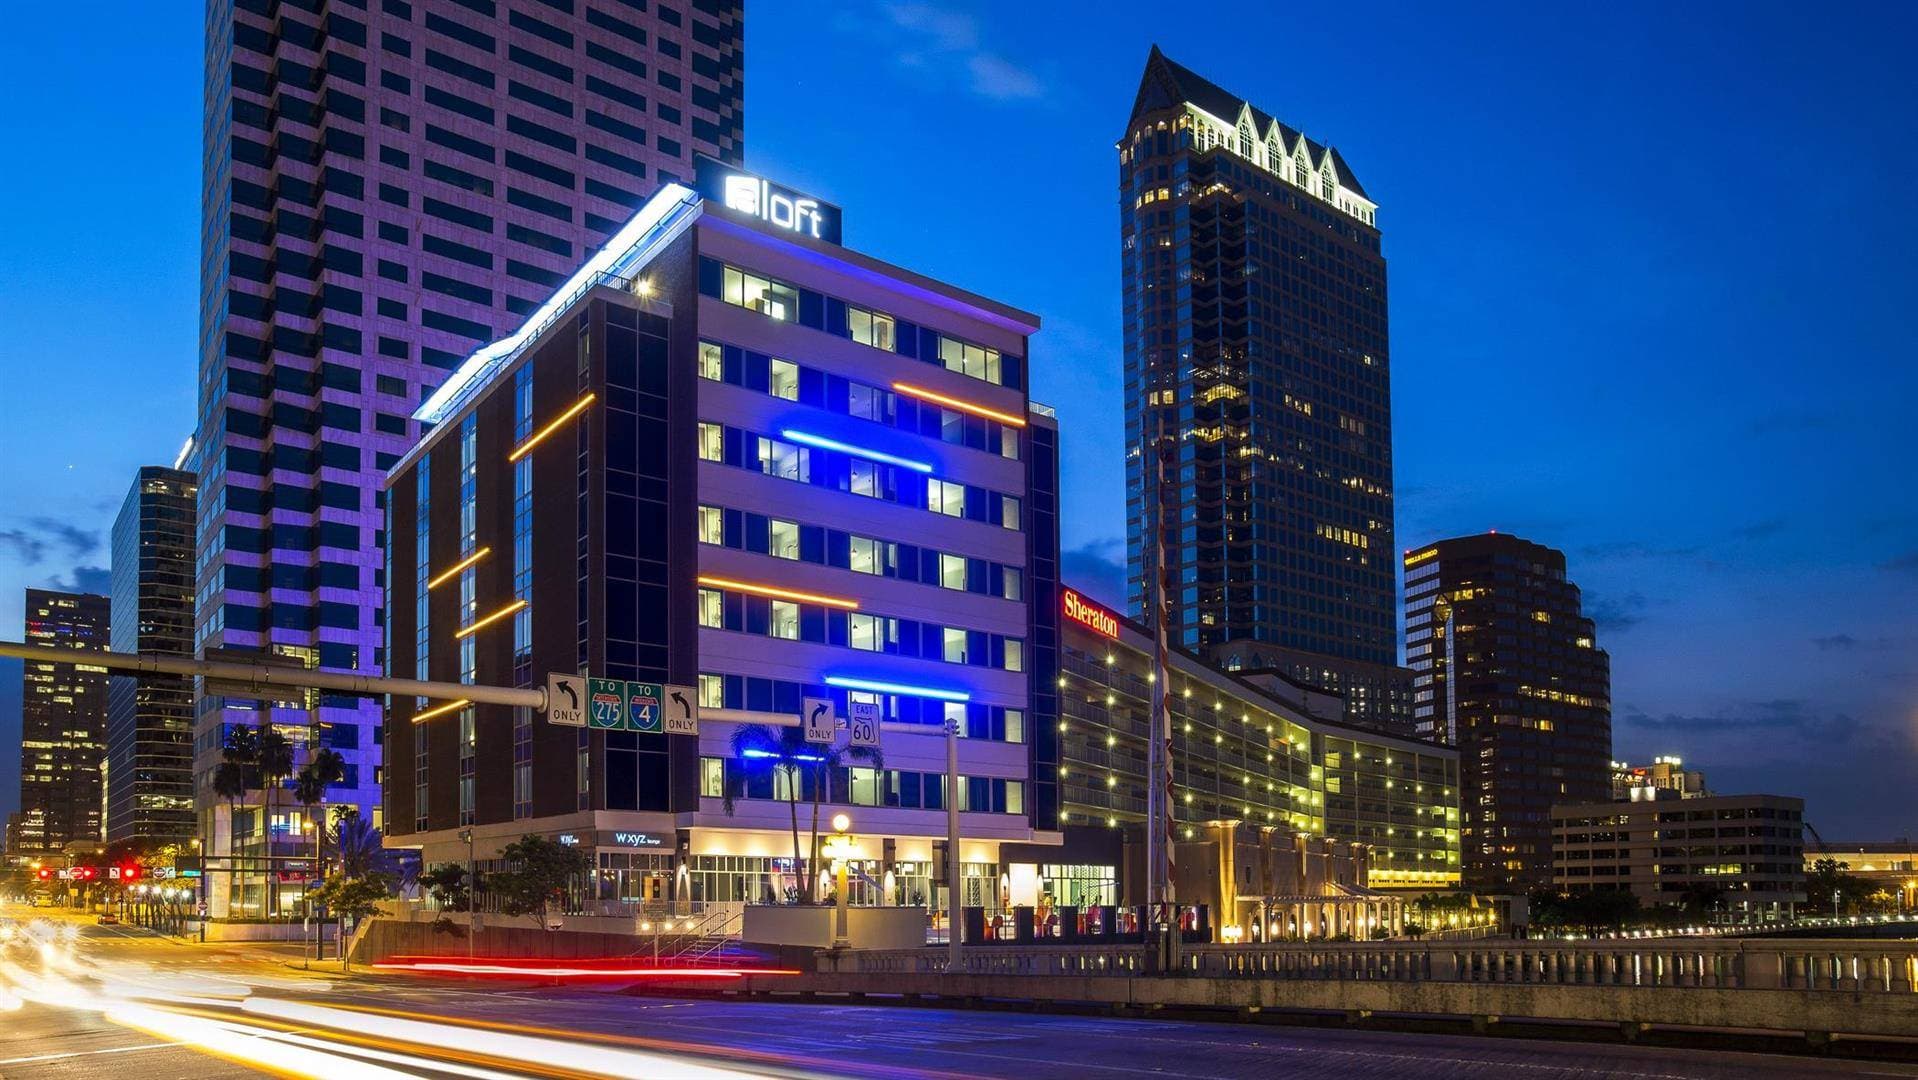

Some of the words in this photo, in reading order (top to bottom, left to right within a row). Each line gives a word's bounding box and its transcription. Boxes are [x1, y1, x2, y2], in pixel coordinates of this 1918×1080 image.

[1065, 591, 1118, 638] Sheraton
[599, 681, 615, 691] TO
[638, 685, 651, 696] TO
[553, 709, 581, 721] ONLY
[597, 701, 619, 721] 275
[638, 705, 651, 723] 4
[856, 705, 873, 714] EAST
[668, 719, 694, 730] ONLY
[809, 729, 832, 739] ONLY
[853, 724, 871, 740] 60
